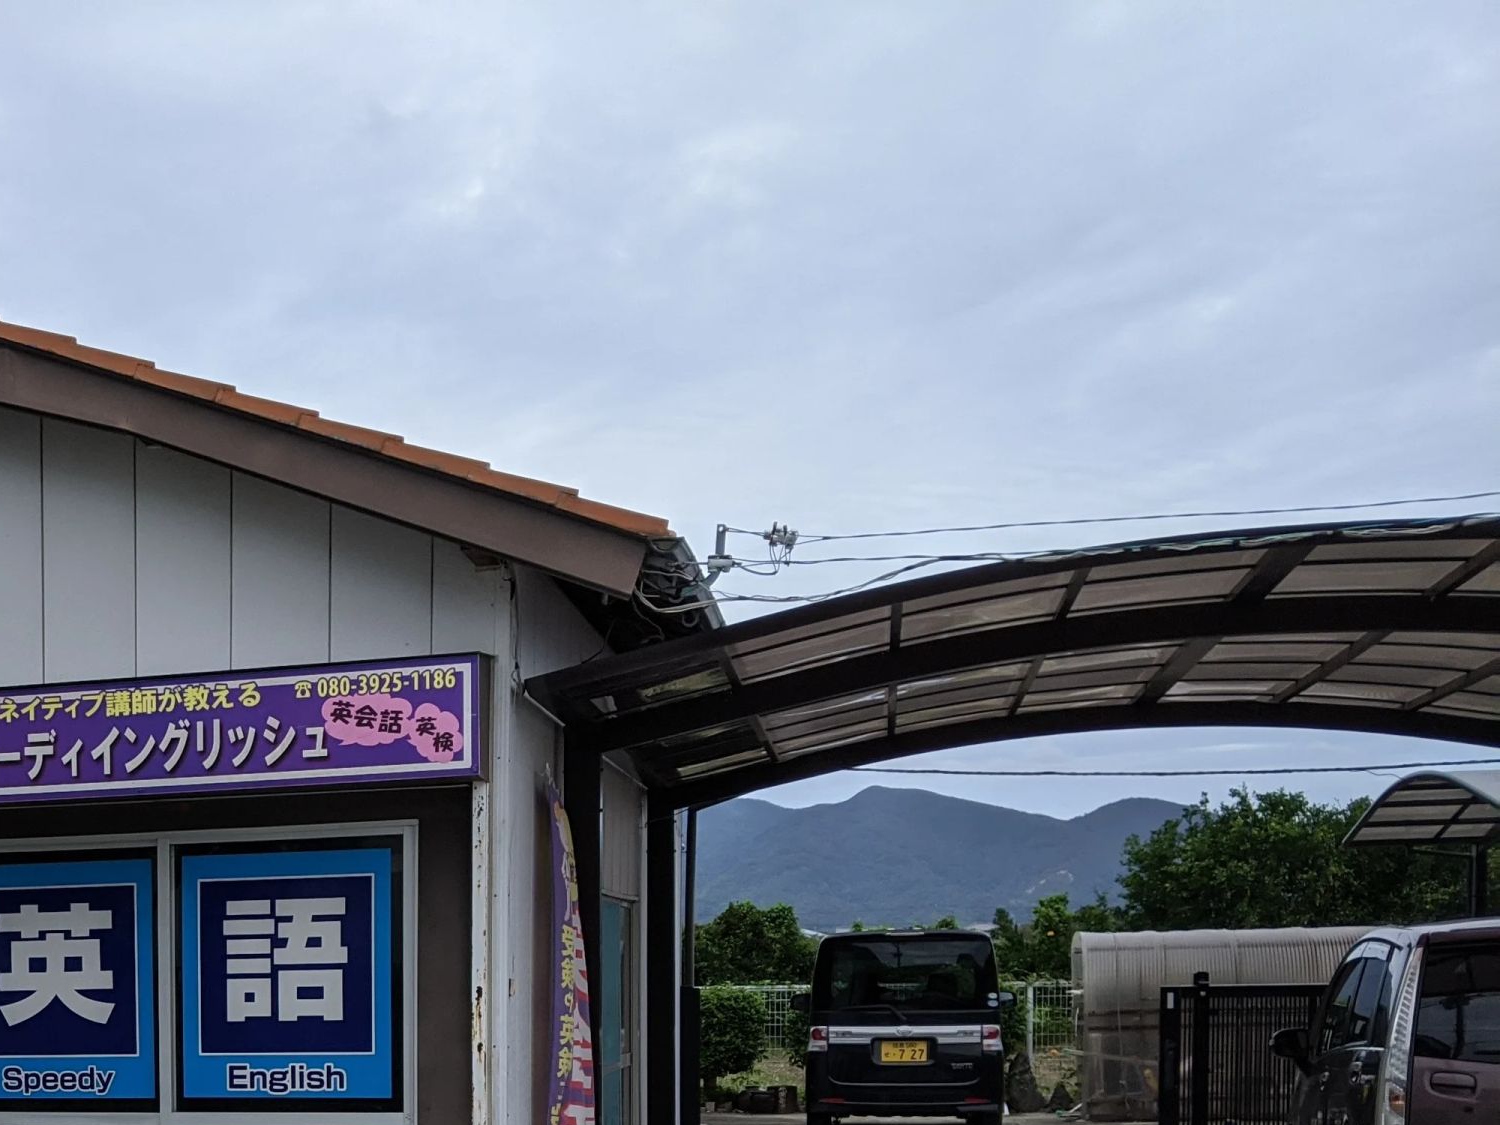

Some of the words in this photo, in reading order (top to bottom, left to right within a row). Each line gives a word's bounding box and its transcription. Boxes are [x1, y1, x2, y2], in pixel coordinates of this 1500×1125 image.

[317, 668, 456, 697] 080-3925-1186
[330, 700, 404, 734] 英会話
[416, 716, 454, 753] 英検
[222, 896, 349, 1023] 語
[2, 1065, 116, 1096] Speedy
[226, 1062, 346, 1096] English
